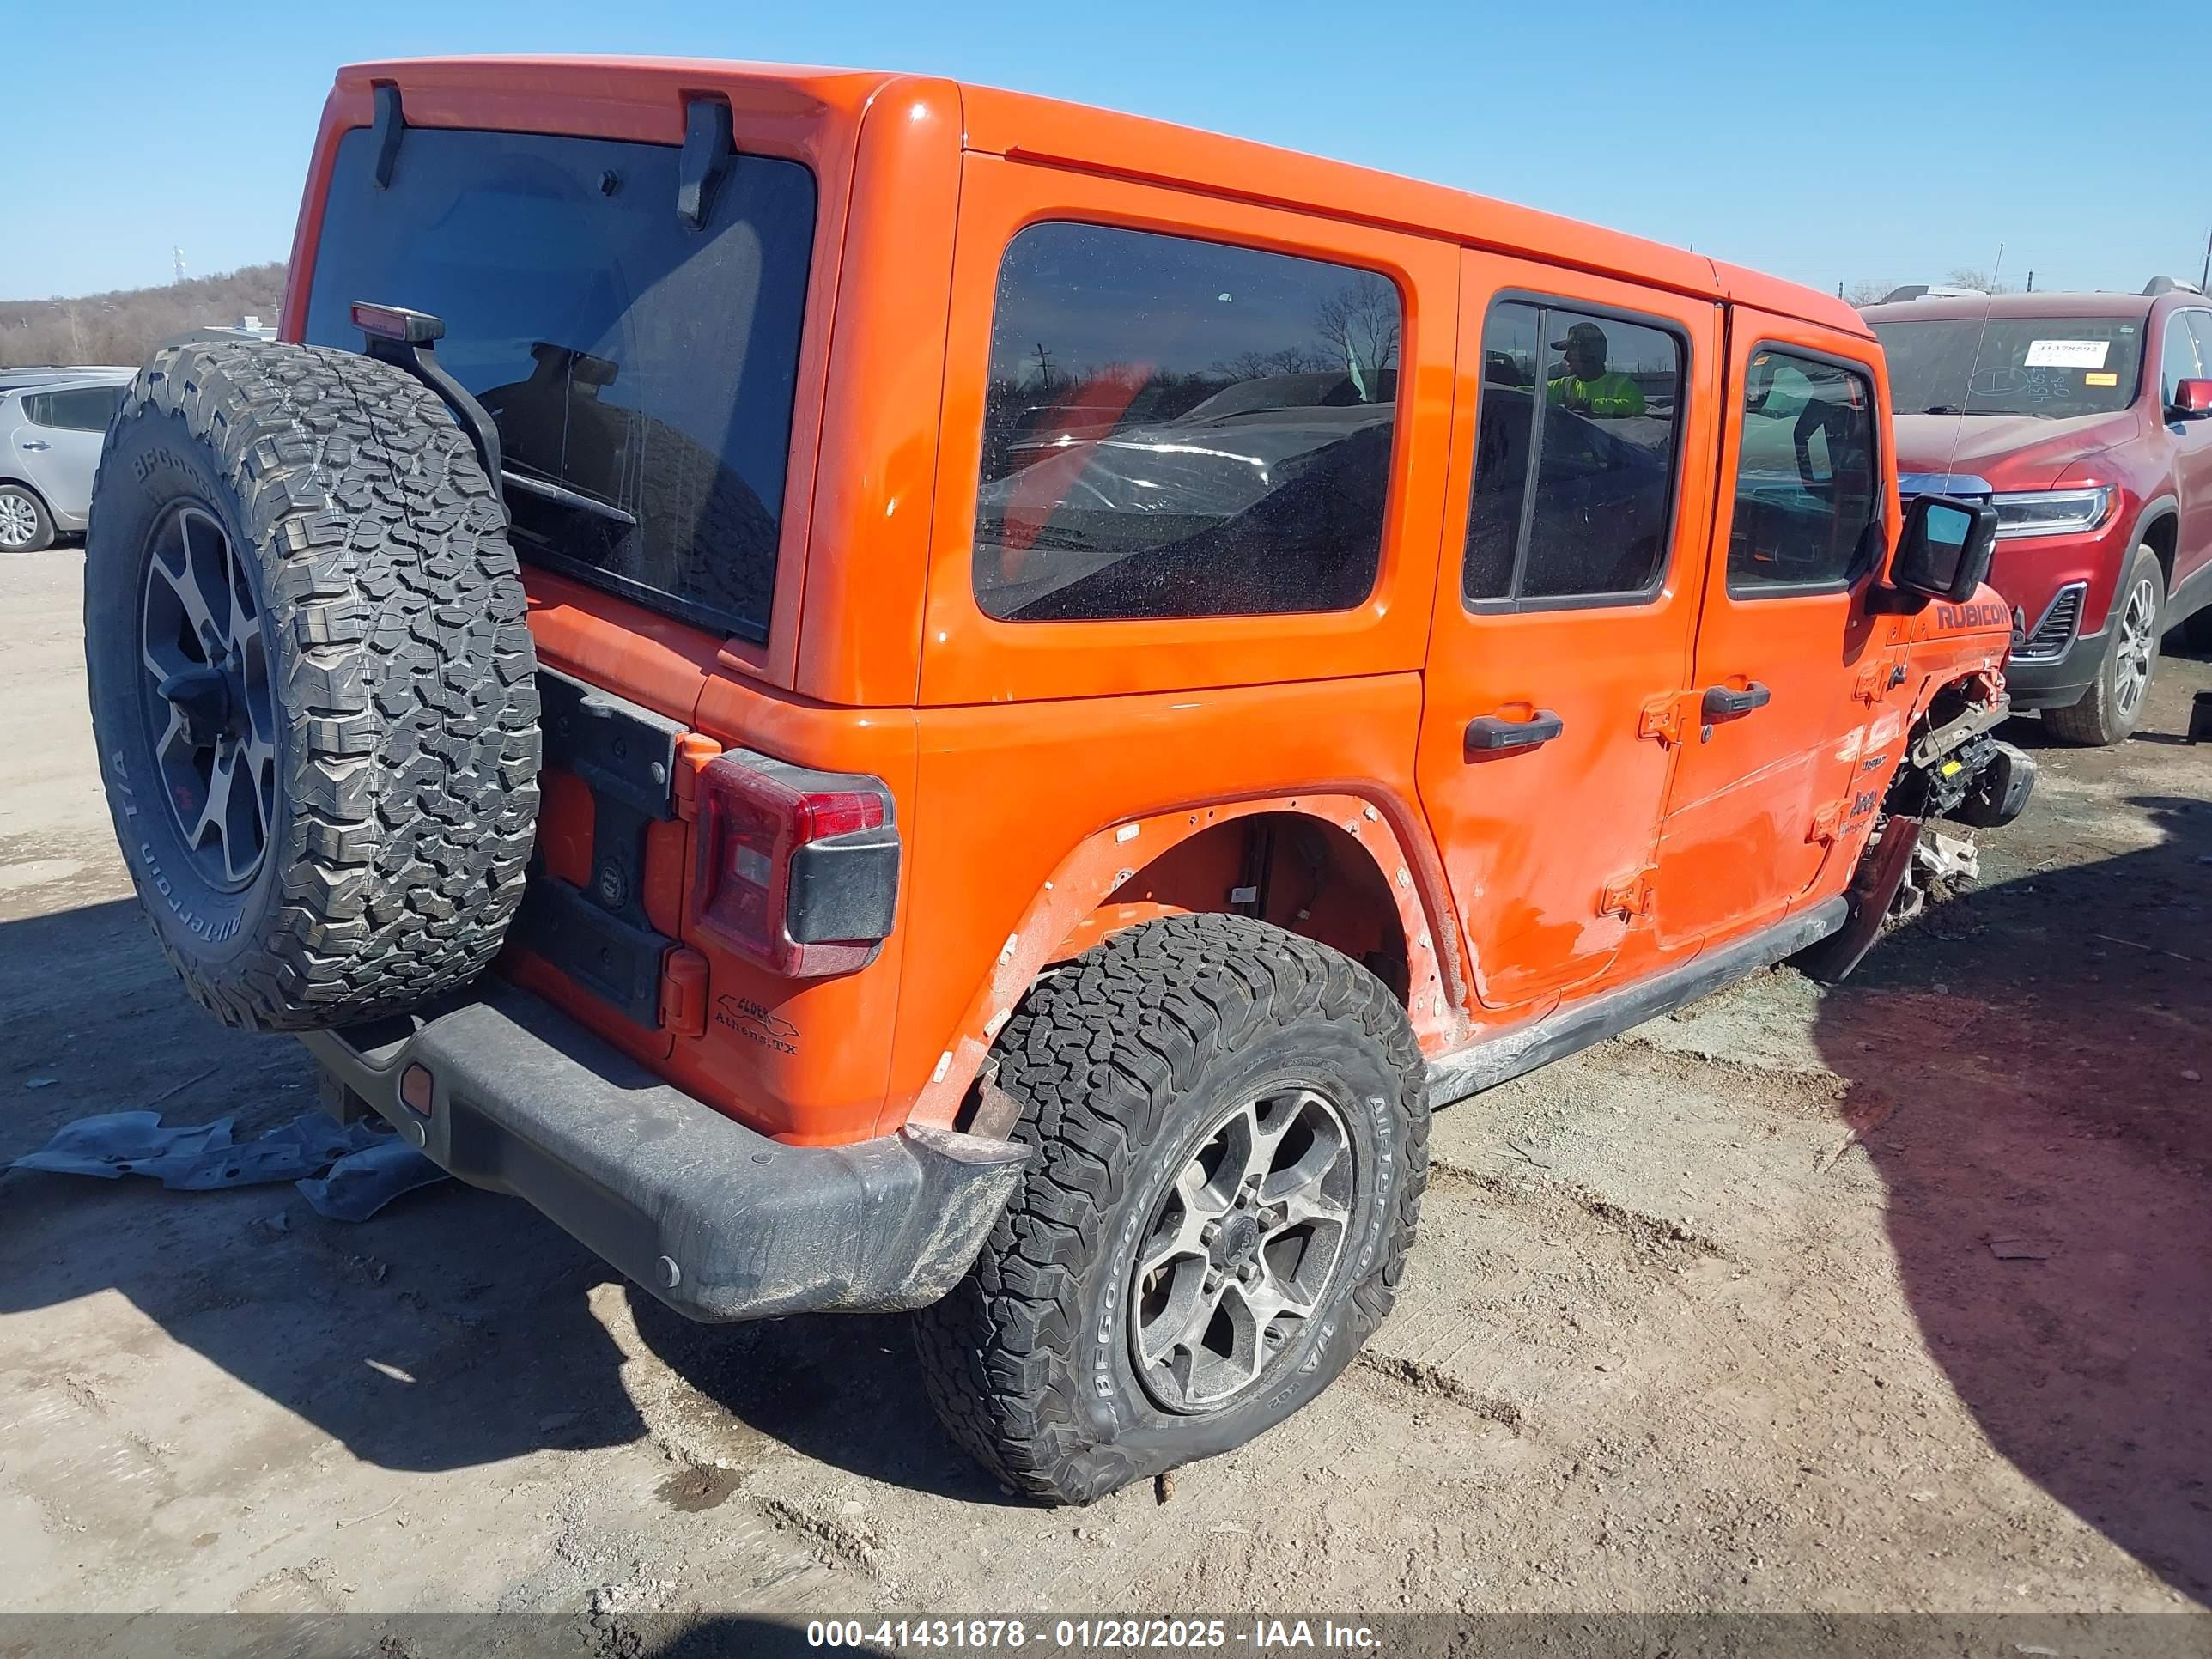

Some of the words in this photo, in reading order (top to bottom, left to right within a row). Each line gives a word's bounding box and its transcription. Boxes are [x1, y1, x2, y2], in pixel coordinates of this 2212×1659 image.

[1936, 604, 2009, 630] RUBICON
[112, 750, 138, 823] T/A
[140, 841, 246, 943] All-Terrain
[1298, 1324, 1334, 1374] T/A
